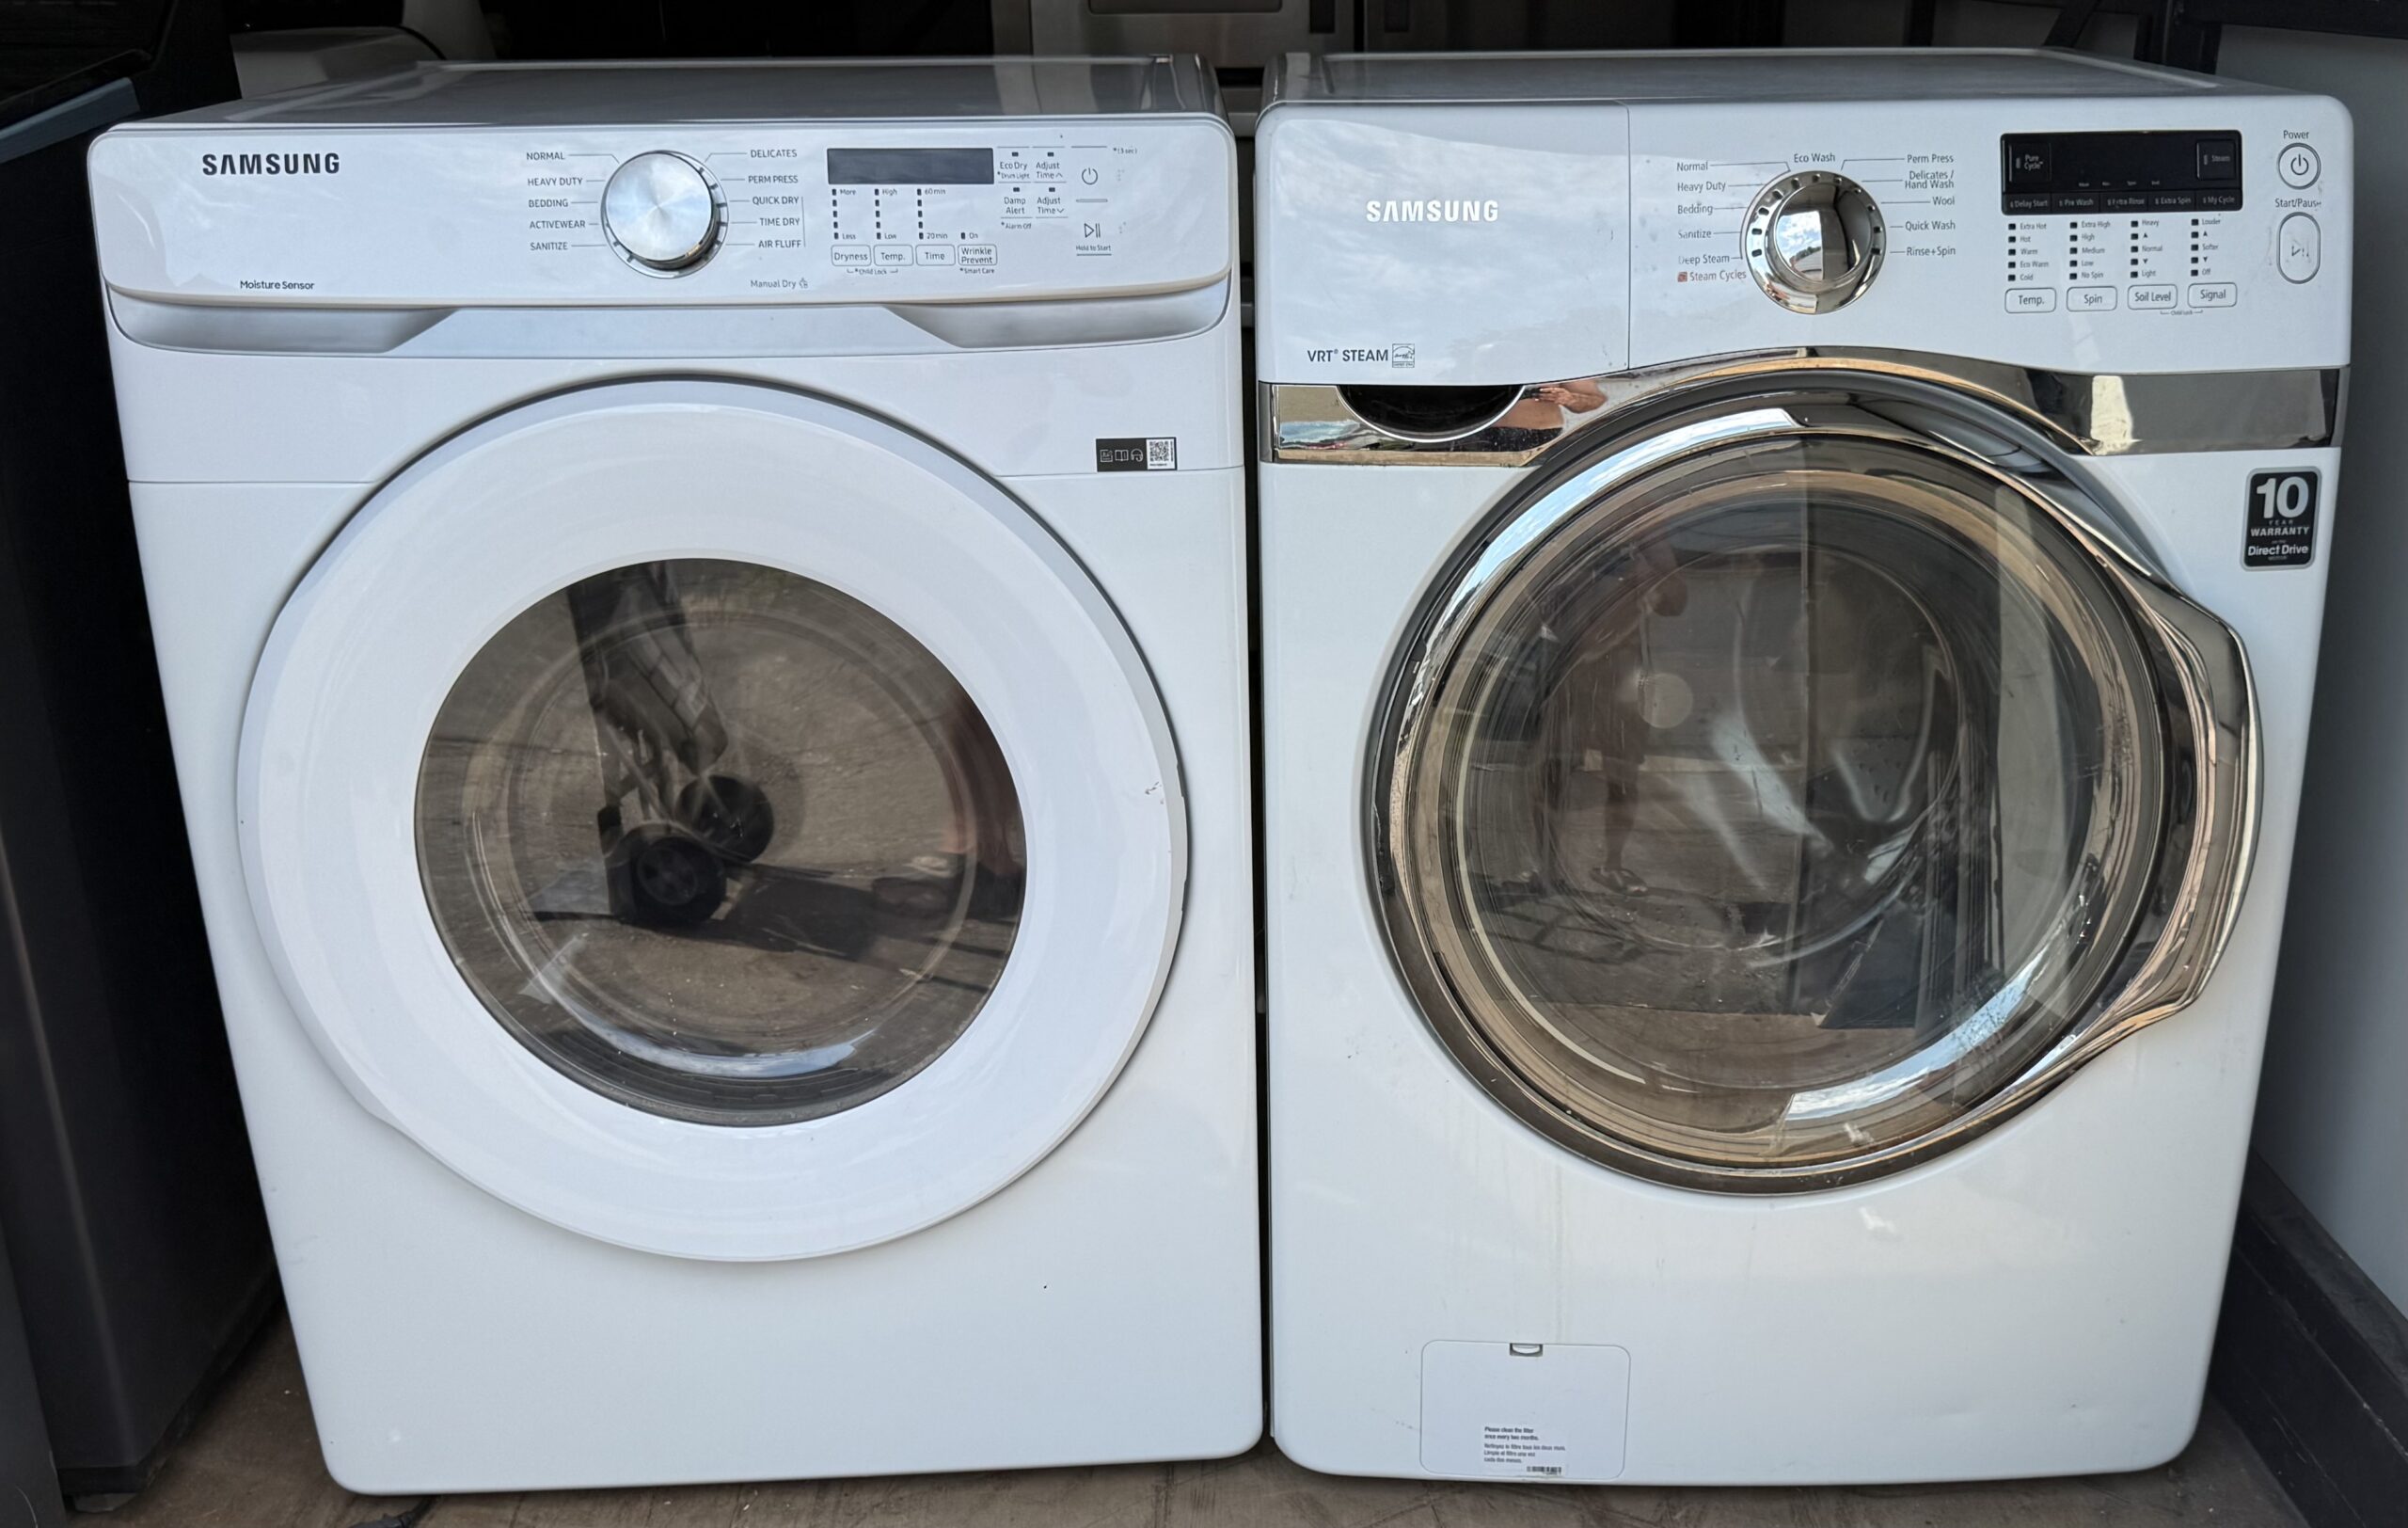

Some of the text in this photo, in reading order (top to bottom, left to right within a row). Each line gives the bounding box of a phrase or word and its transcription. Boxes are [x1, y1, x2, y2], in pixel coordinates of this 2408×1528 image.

[2283, 130, 2309, 139] Power
[751, 149, 798, 158] DELICATES
[1794, 152, 1835, 163] Eco Wash
[202, 153, 340, 175] SAMSUNG
[1908, 154, 1955, 164] Perm Press
[1014, 162, 1027, 170] Dry
[1037, 162, 1059, 170] Adjust
[1677, 162, 1708, 171] Normal
[749, 175, 798, 183] PERM PRESS
[1909, 170, 1948, 180] Delicates
[528, 177, 583, 186] HEAVY DUTY
[1930, 179, 1955, 188] Wash
[1678, 182, 1726, 194] Heavy Duty
[529, 199, 568, 207] BEDDING
[752, 196, 799, 205] QUICK DRY
[1037, 197, 1061, 205] Adjust
[1932, 196, 1955, 205] Wool
[1366, 199, 1498, 222] SAMSUNG
[1678, 205, 1713, 215] Bedding
[530, 220, 585, 229] ACTIVEWEAR
[1905, 220, 1956, 231] Quick Wash
[531, 242, 568, 250] SANITIZE
[758, 240, 801, 248] AIR FLUFF
[833, 252, 868, 262] Dryness
[880, 252, 905, 262] Temp.
[1907, 247, 1956, 258] Rinse+Spin
[1703, 254, 1730, 263] Steam
[1689, 269, 1746, 282] Steam Cycles
[240, 280, 315, 290] Moisture Sensor
[783, 279, 797, 290] Dry
[2084, 294, 2102, 306] Spin
[2135, 292, 2171, 301] Soil Level
[2201, 289, 2226, 301] Signal
[2019, 295, 2045, 307] Temp.
[1342, 349, 1388, 361] STEAM
[2256, 476, 2309, 518] 10
[2250, 527, 2310, 536] WARRANTY
[2248, 544, 2308, 556] Direct Drive
